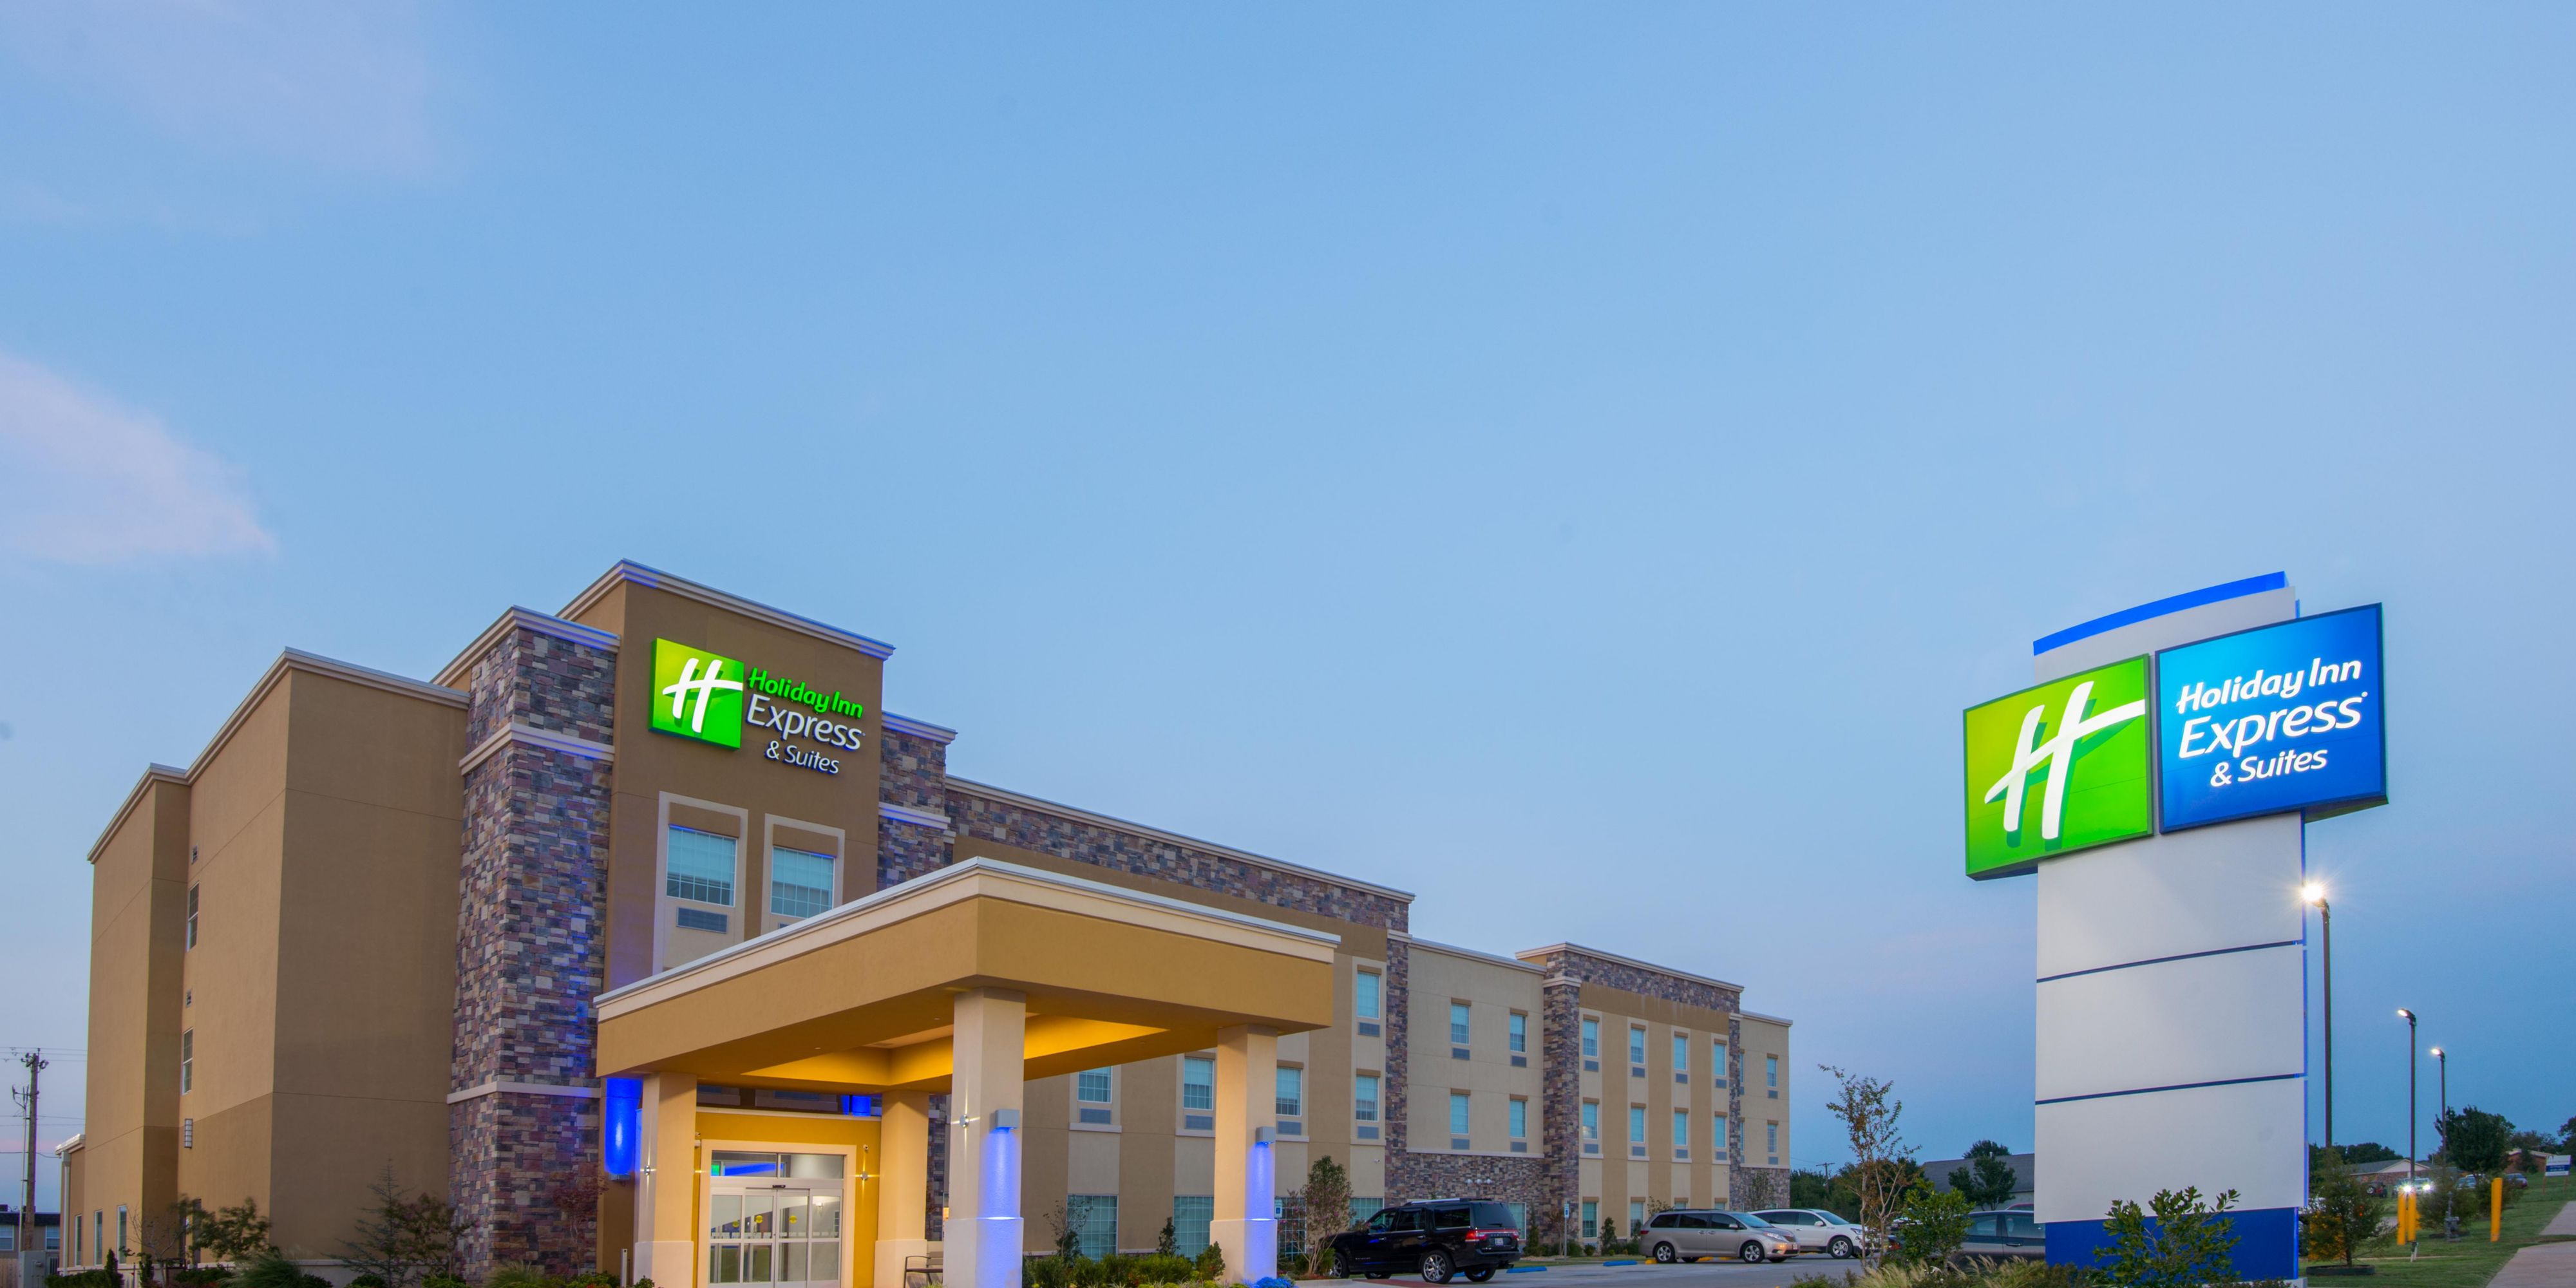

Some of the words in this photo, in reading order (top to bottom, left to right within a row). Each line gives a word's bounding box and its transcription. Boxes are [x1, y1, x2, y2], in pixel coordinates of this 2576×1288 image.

[748, 667, 829, 714] Holiday
[832, 691, 863, 719] Inn
[2177, 668, 2303, 714] Holiday
[2309, 658, 2362, 687] Inn
[746, 693, 862, 751] Express
[2179, 699, 2363, 759] Express
[765, 741, 780, 761] &
[784, 744, 840, 775] Suites
[2210, 762, 2231, 788] &
[2237, 749, 2328, 783] Suites
